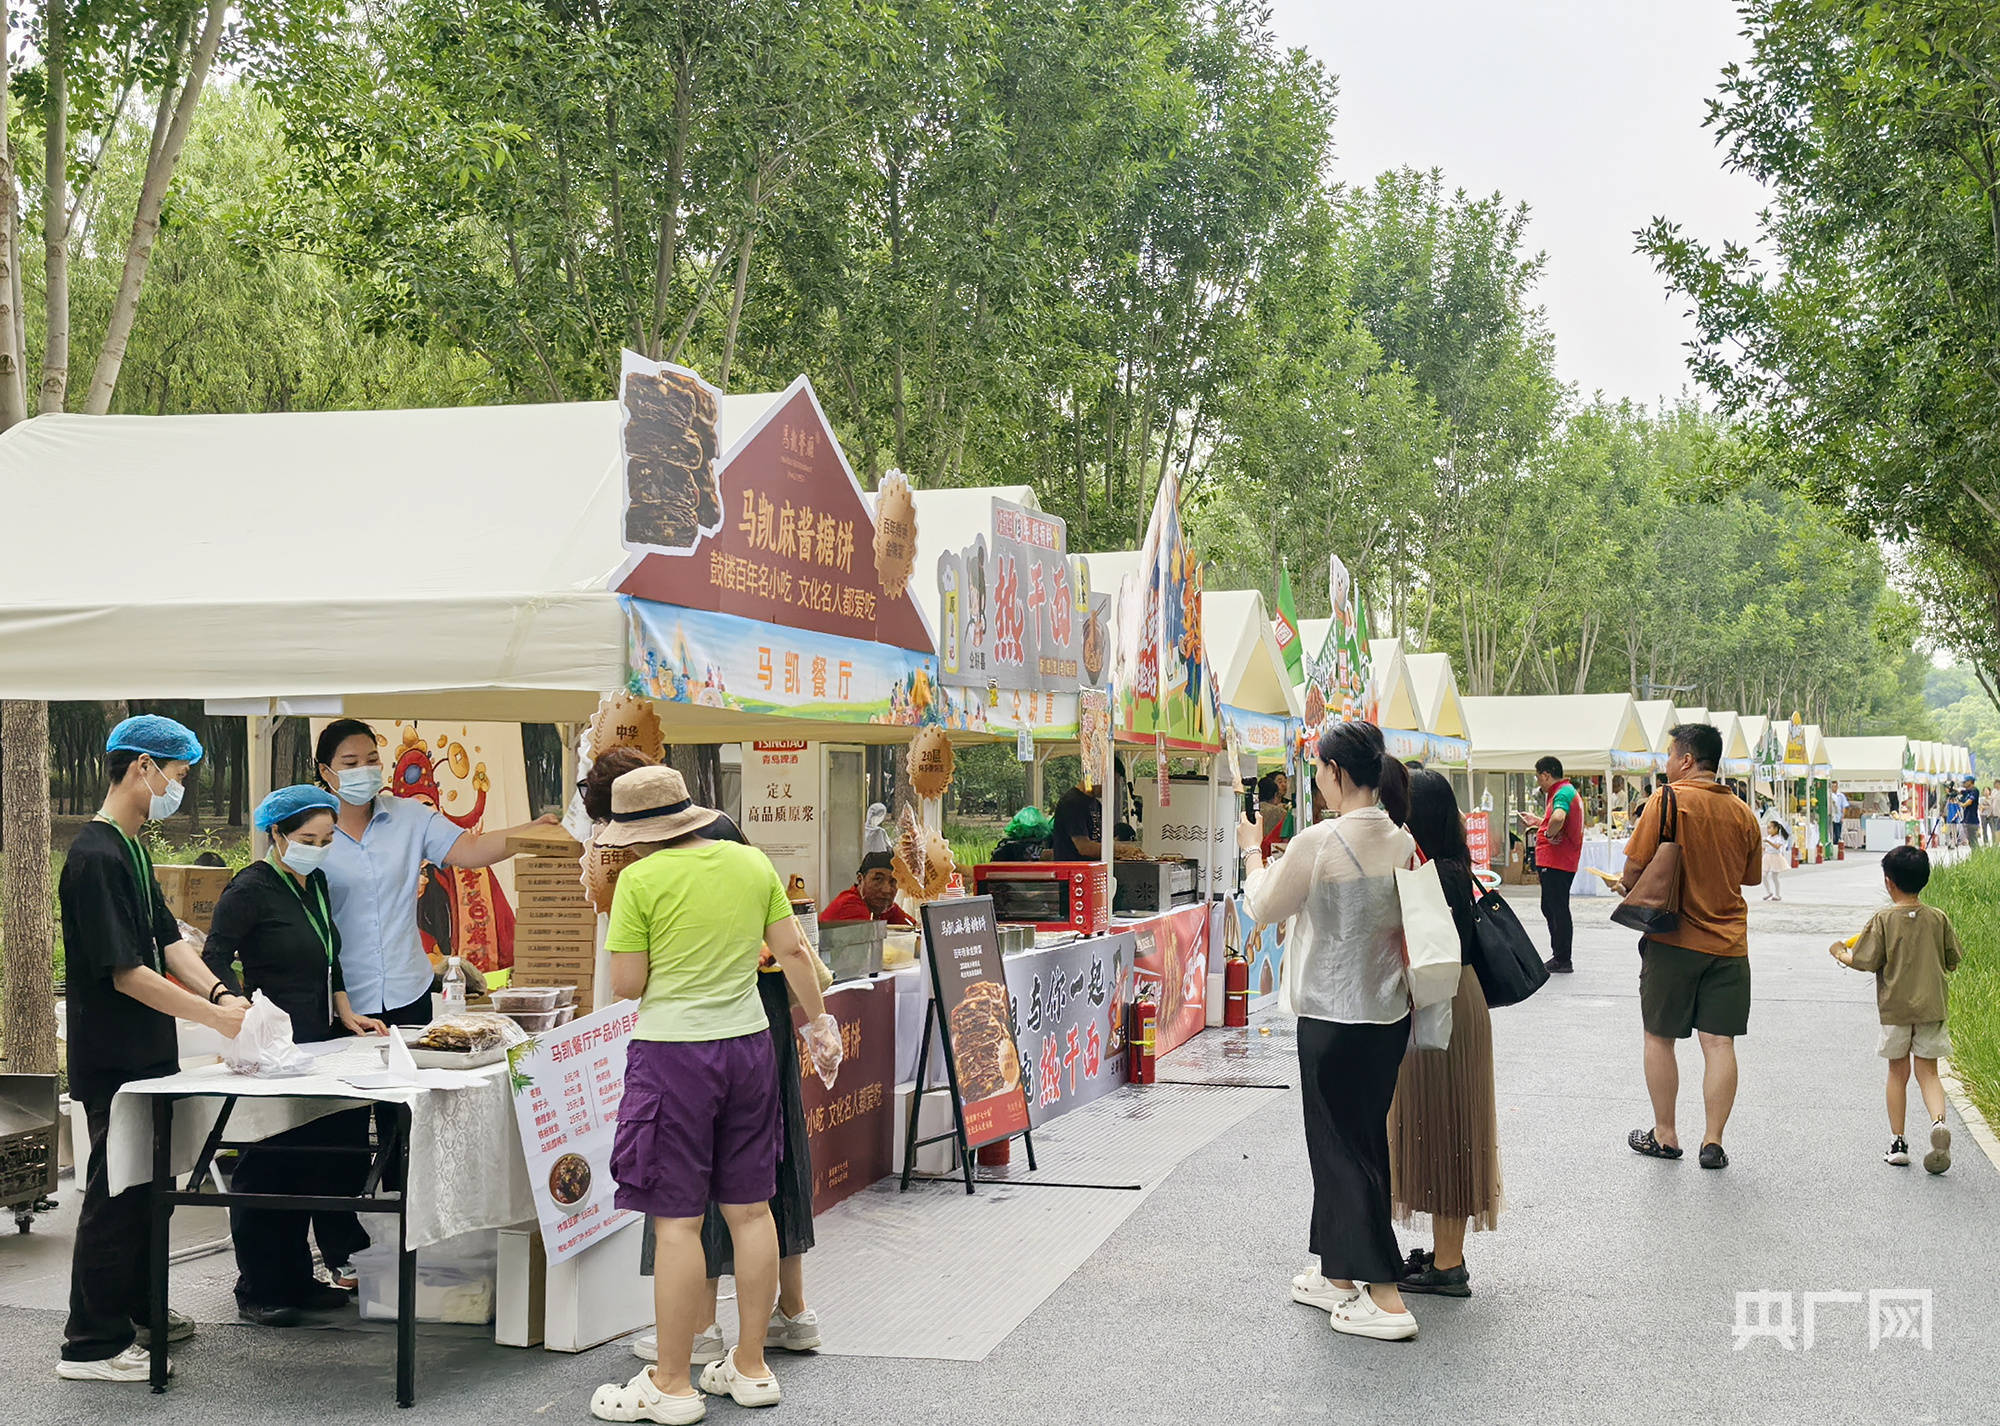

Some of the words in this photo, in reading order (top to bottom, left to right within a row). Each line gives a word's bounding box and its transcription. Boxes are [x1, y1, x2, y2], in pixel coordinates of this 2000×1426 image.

[739, 488, 855, 574] 马凯麻酱糖饼
[710, 549, 793, 603] 鼓楼百年名小吃
[797, 575, 878, 621] 文化名人都爱吃
[757, 646, 853, 700] 马凯餐厅
[616, 724, 639, 742] 中华
[766, 782, 793, 799] 定义
[748, 804, 815, 823] 高品质原浆
